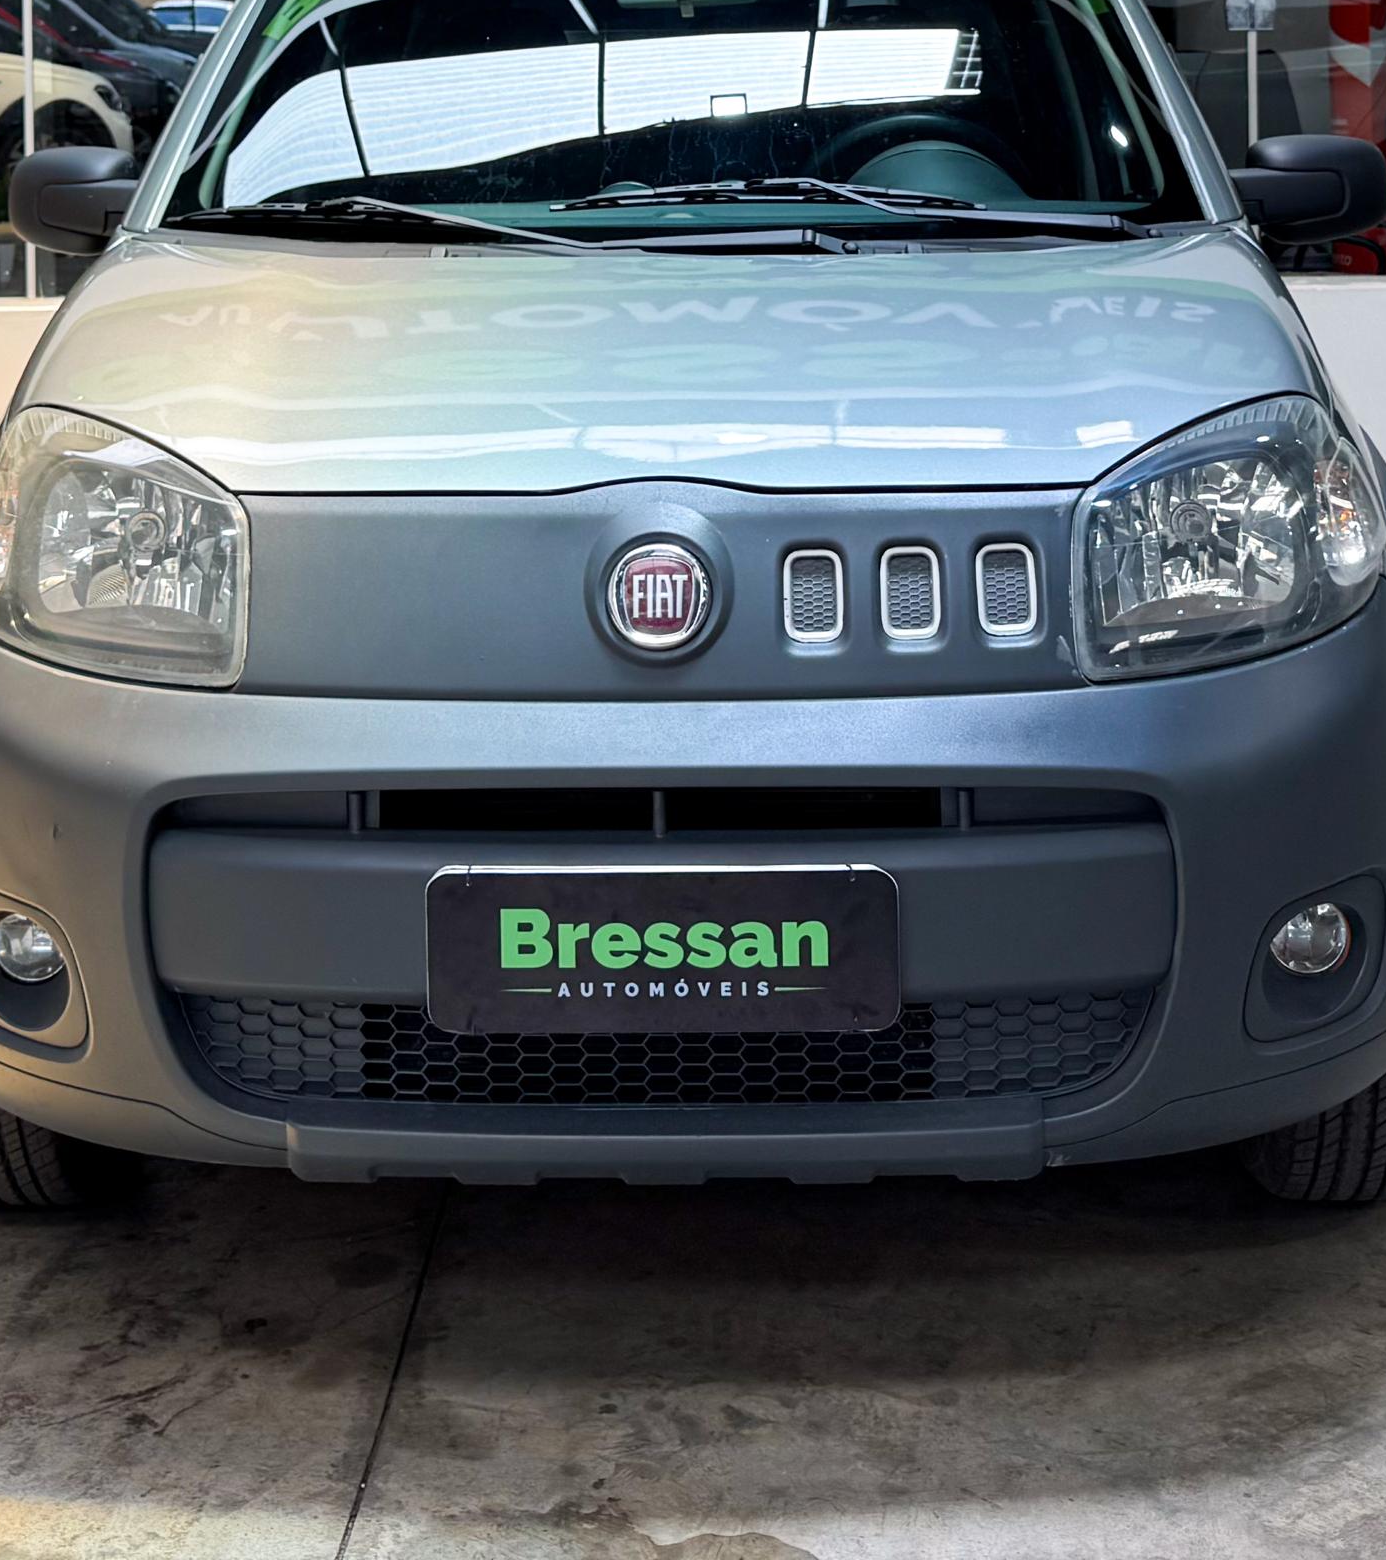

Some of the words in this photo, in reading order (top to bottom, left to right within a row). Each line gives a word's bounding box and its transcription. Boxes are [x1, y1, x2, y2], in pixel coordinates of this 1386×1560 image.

[632, 574, 688, 619] FIAT
[499, 908, 829, 969] Bressan
[557, 978, 770, 998] AUTOMÓVEIS
